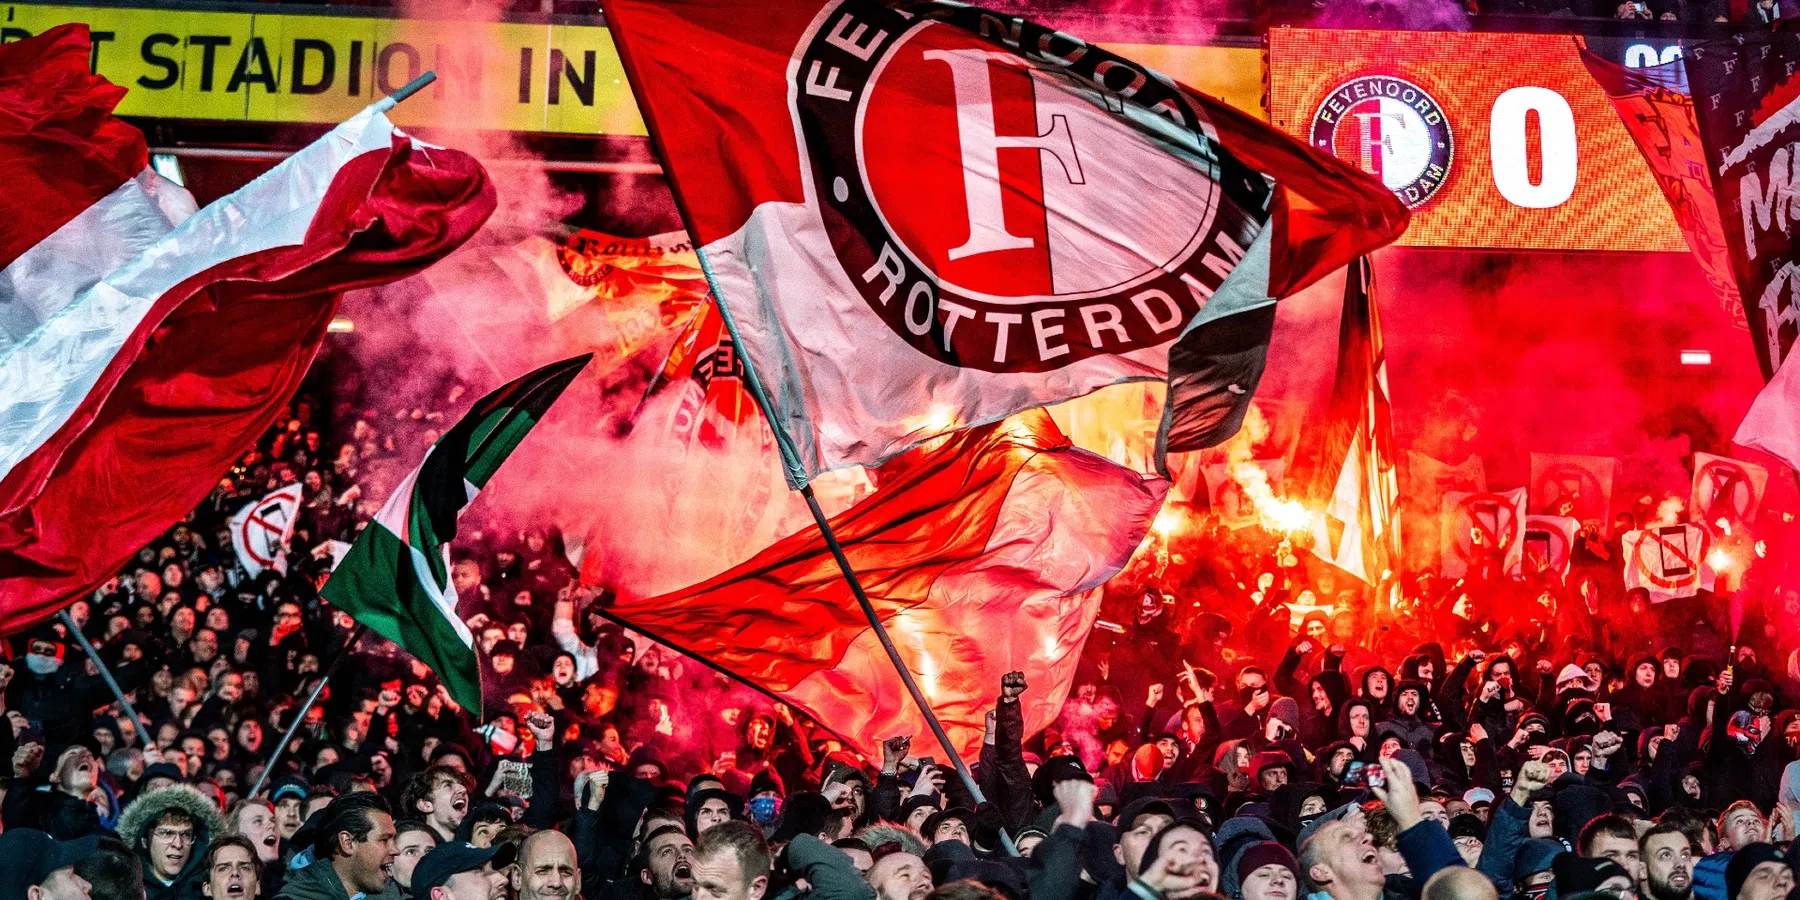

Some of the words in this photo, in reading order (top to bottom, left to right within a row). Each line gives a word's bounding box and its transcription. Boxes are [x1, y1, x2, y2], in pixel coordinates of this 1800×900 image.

[137, 33, 483, 99] STADION
[519, 47, 596, 107] IN
[1321, 80, 1442, 126] FEYENOORD
[1489, 86, 1578, 209] 0
